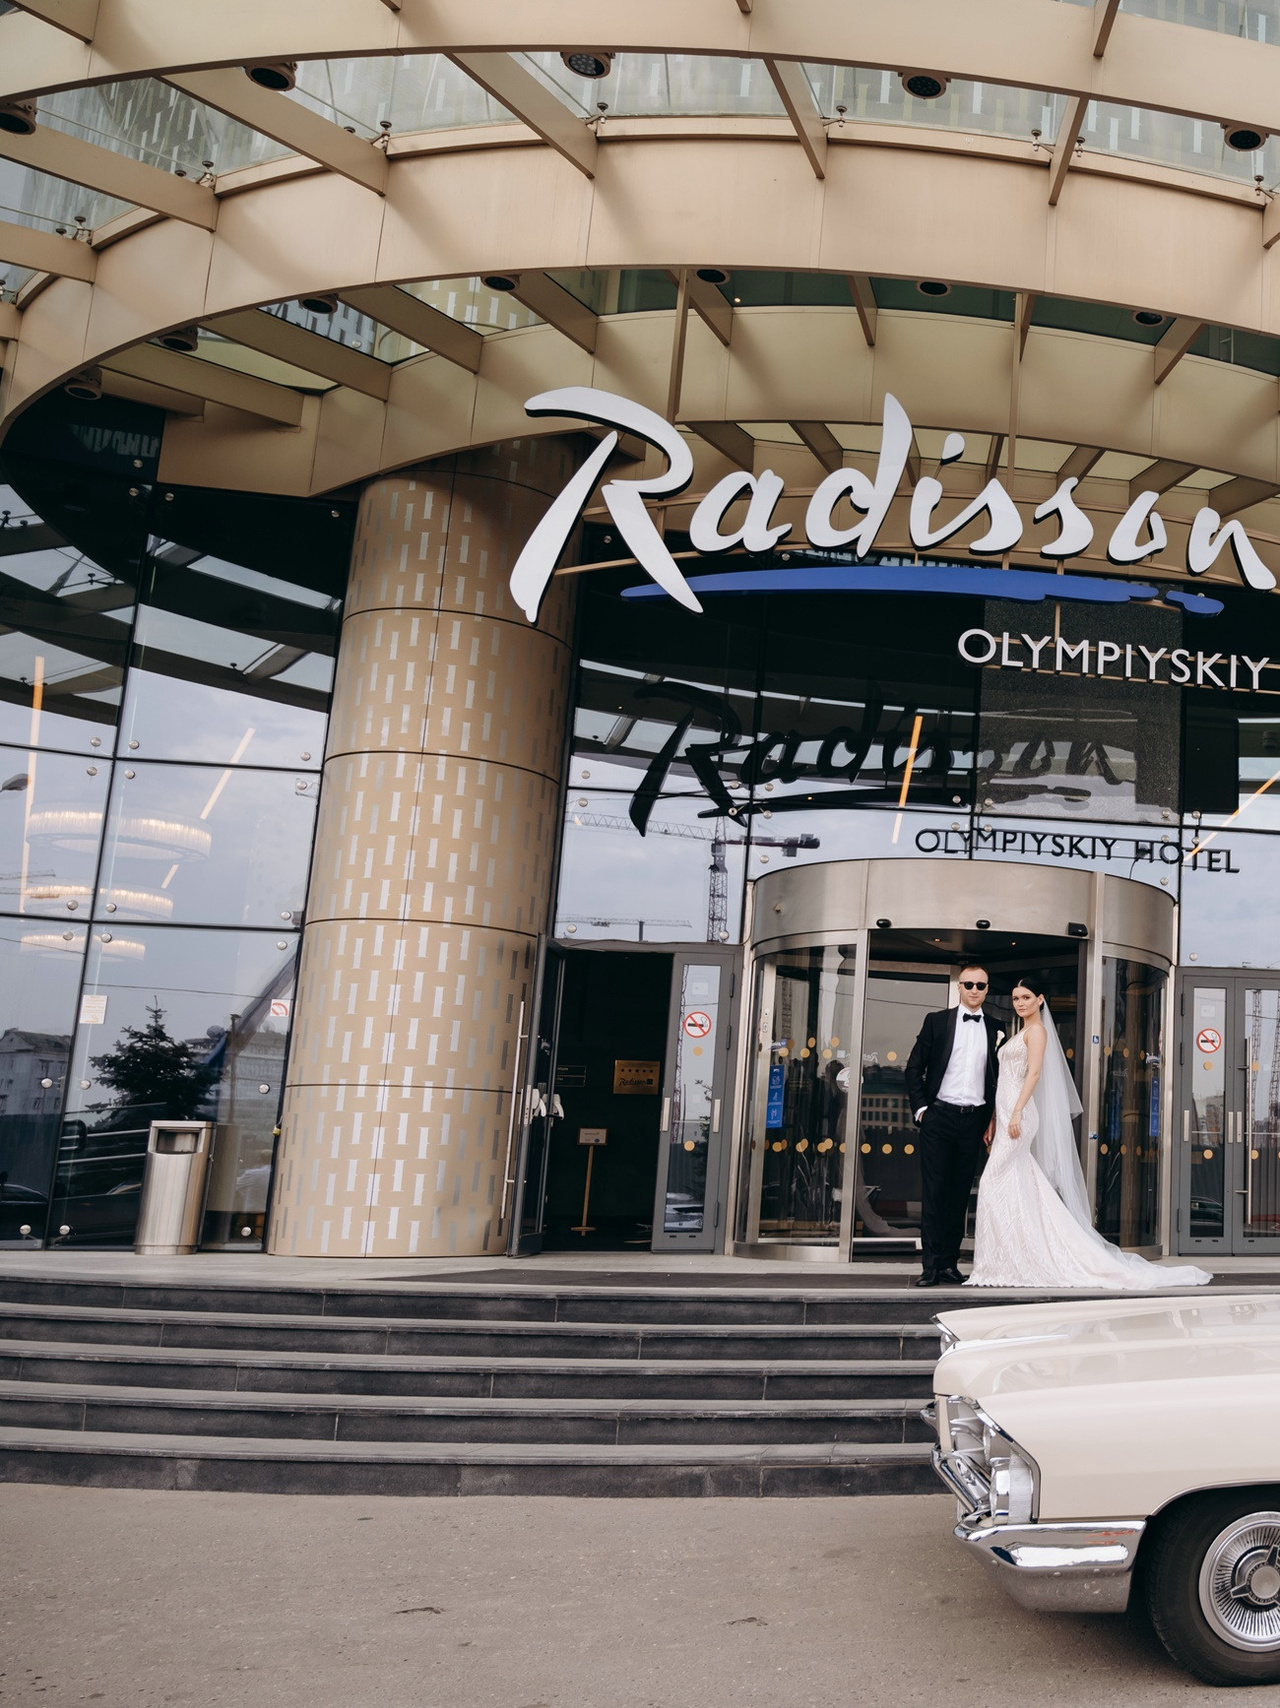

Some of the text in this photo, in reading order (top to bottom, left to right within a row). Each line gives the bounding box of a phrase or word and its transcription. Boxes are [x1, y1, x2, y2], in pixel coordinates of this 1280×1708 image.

[510, 386, 1277, 622] Radisson
[956, 627, 1270, 693] OLYMPIYSKIY
[914, 827, 1241, 875] OLYMPIYSKIY HOTEL
